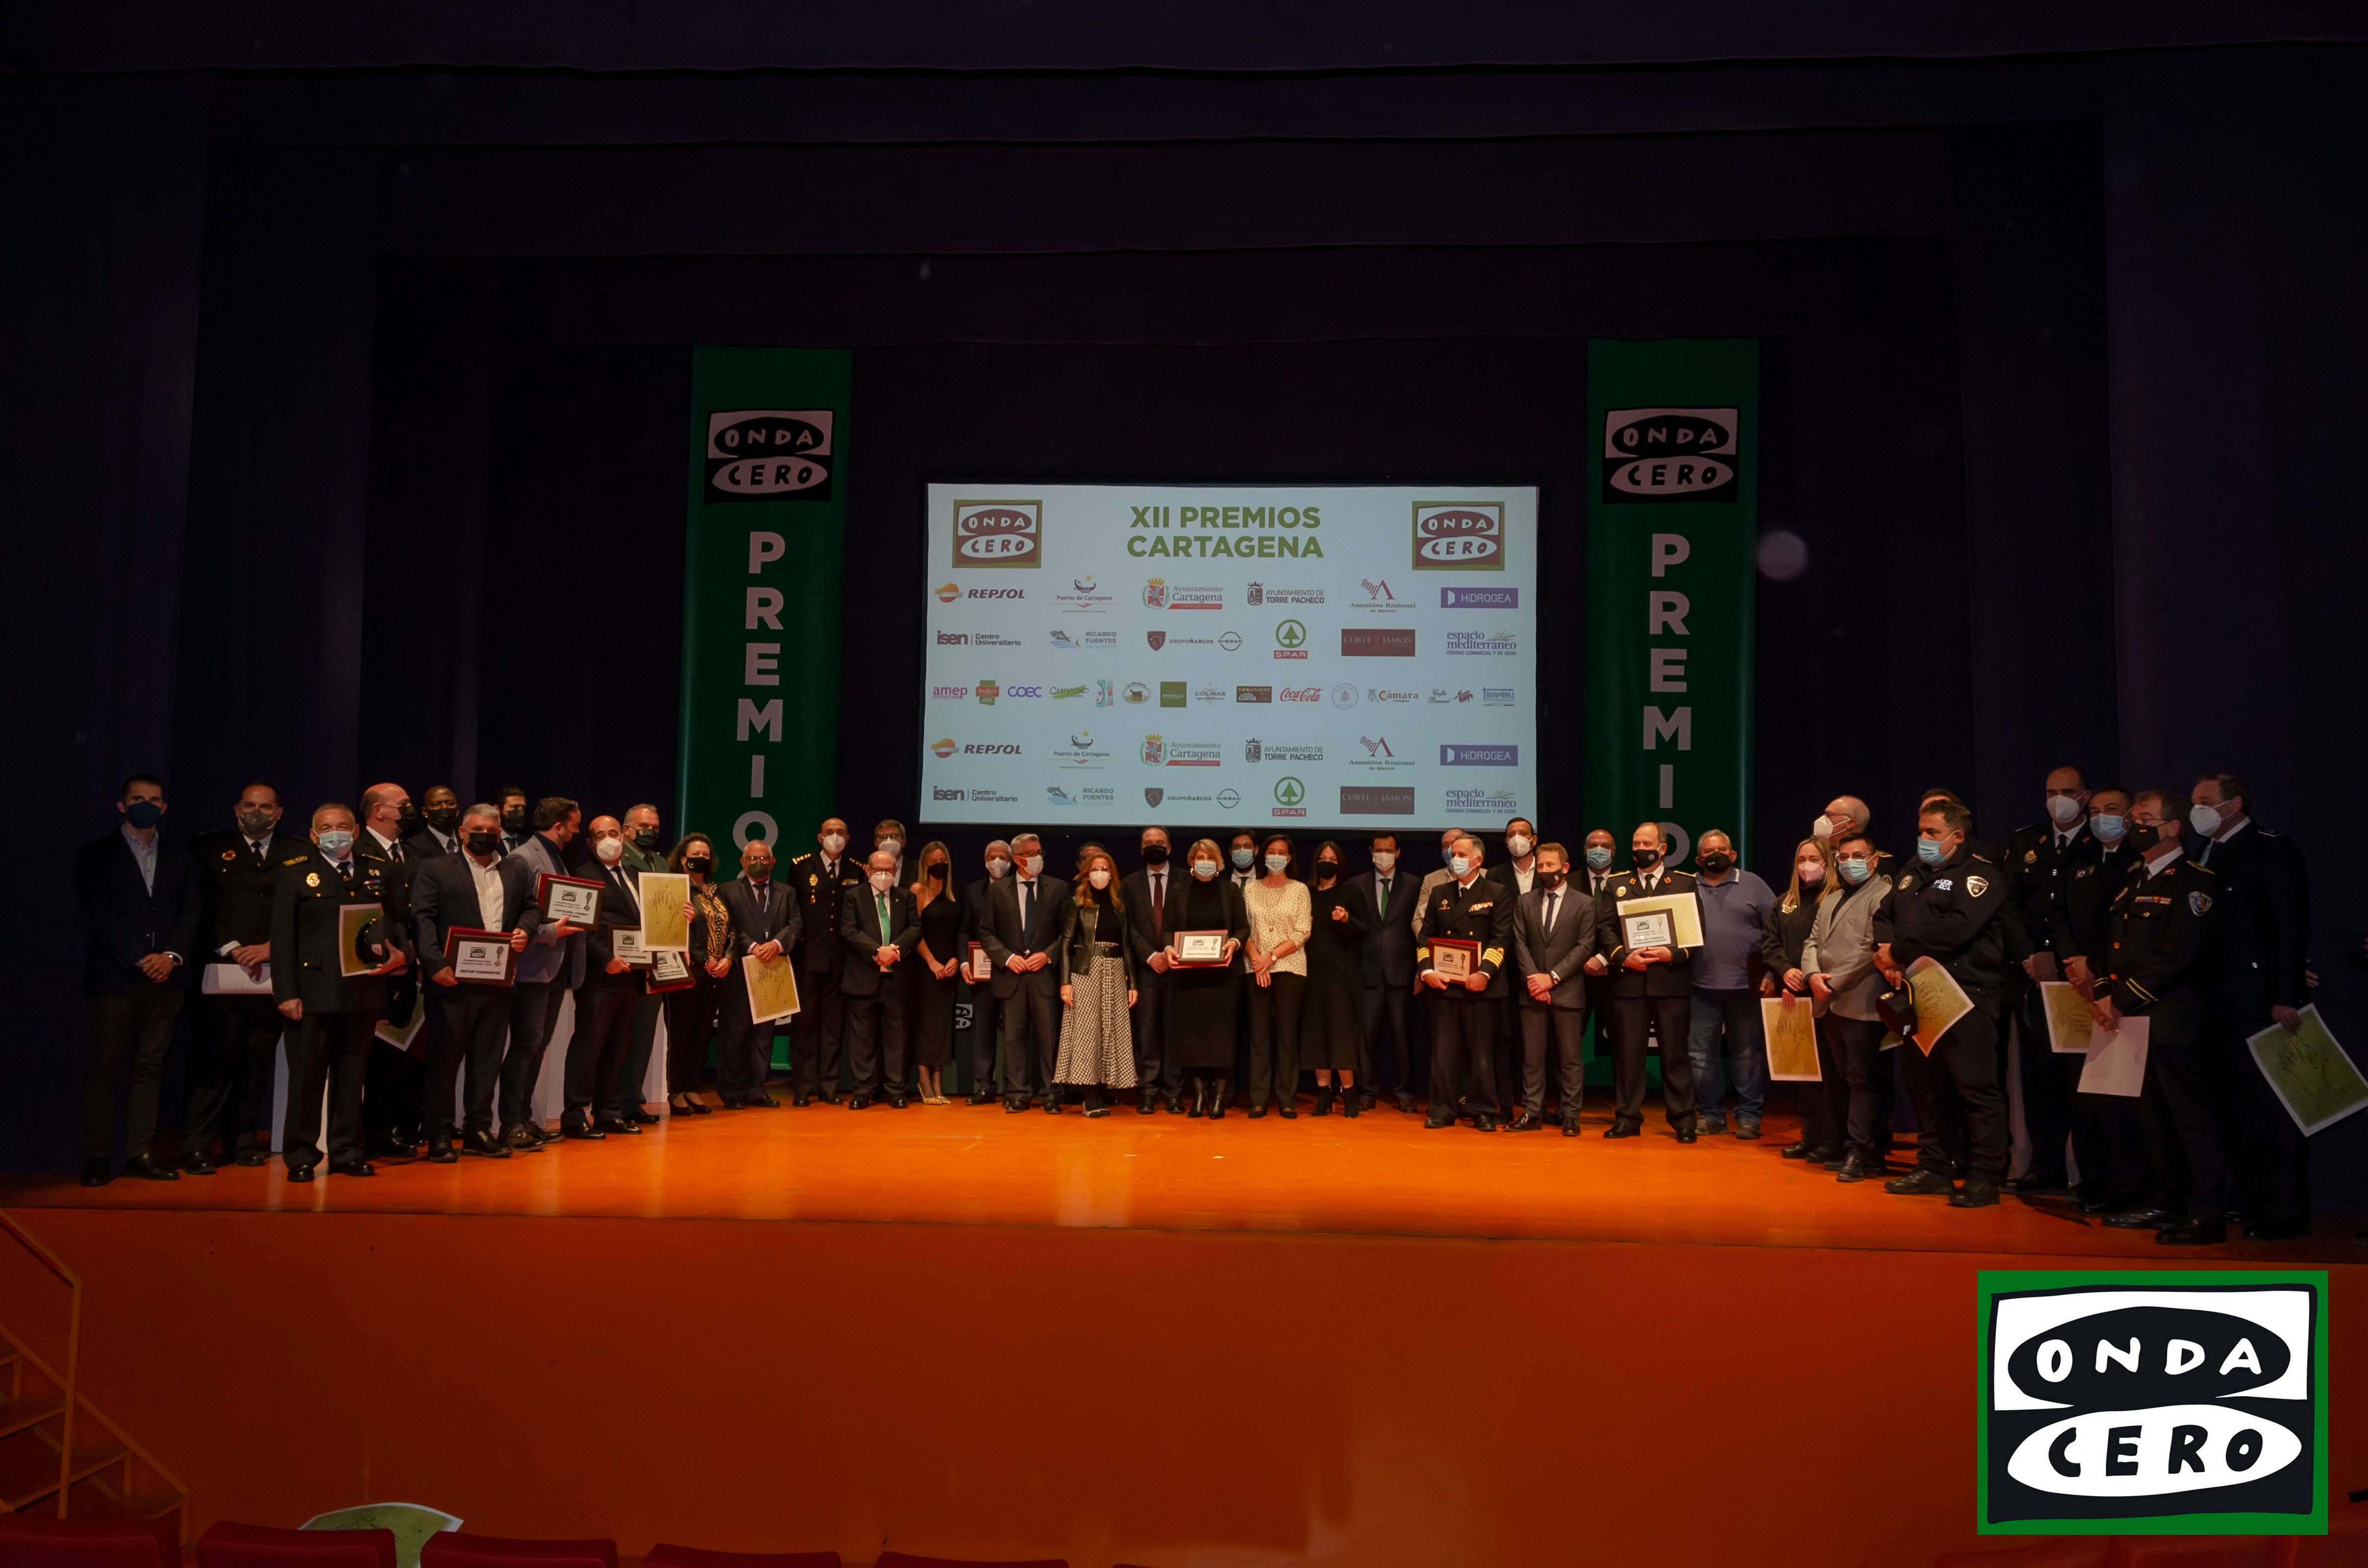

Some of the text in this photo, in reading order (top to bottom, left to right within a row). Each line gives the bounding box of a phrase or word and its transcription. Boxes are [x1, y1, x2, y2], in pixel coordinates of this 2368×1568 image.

[725, 429, 813, 447] ONDA
[1623, 427, 1717, 446] ONDA
[728, 465, 813, 485] CERO
[1628, 465, 1717, 486] CERO
[968, 516, 1026, 529] ONDA
[1130, 506, 1320, 529] XII PREMIOS
[1428, 518, 1488, 530] ONDA
[971, 539, 1025, 553] CERO
[1127, 535, 1324, 558] CARTAGENA
[1431, 541, 1488, 555] CERO
[968, 589, 1024, 599] REPSOL
[1172, 592, 1222, 603] Cartagena
[937, 630, 968, 645] isen
[1447, 631, 1484, 642] espacio
[933, 686, 968, 699] amep
[1379, 690, 1418, 701] Cámara
[733, 532, 784, 878] PREMIO
[964, 745, 1022, 754] REPSOL
[1171, 748, 1221, 759] Cartagena
[933, 786, 964, 801] isen
[1446, 788, 1484, 799] espacio
